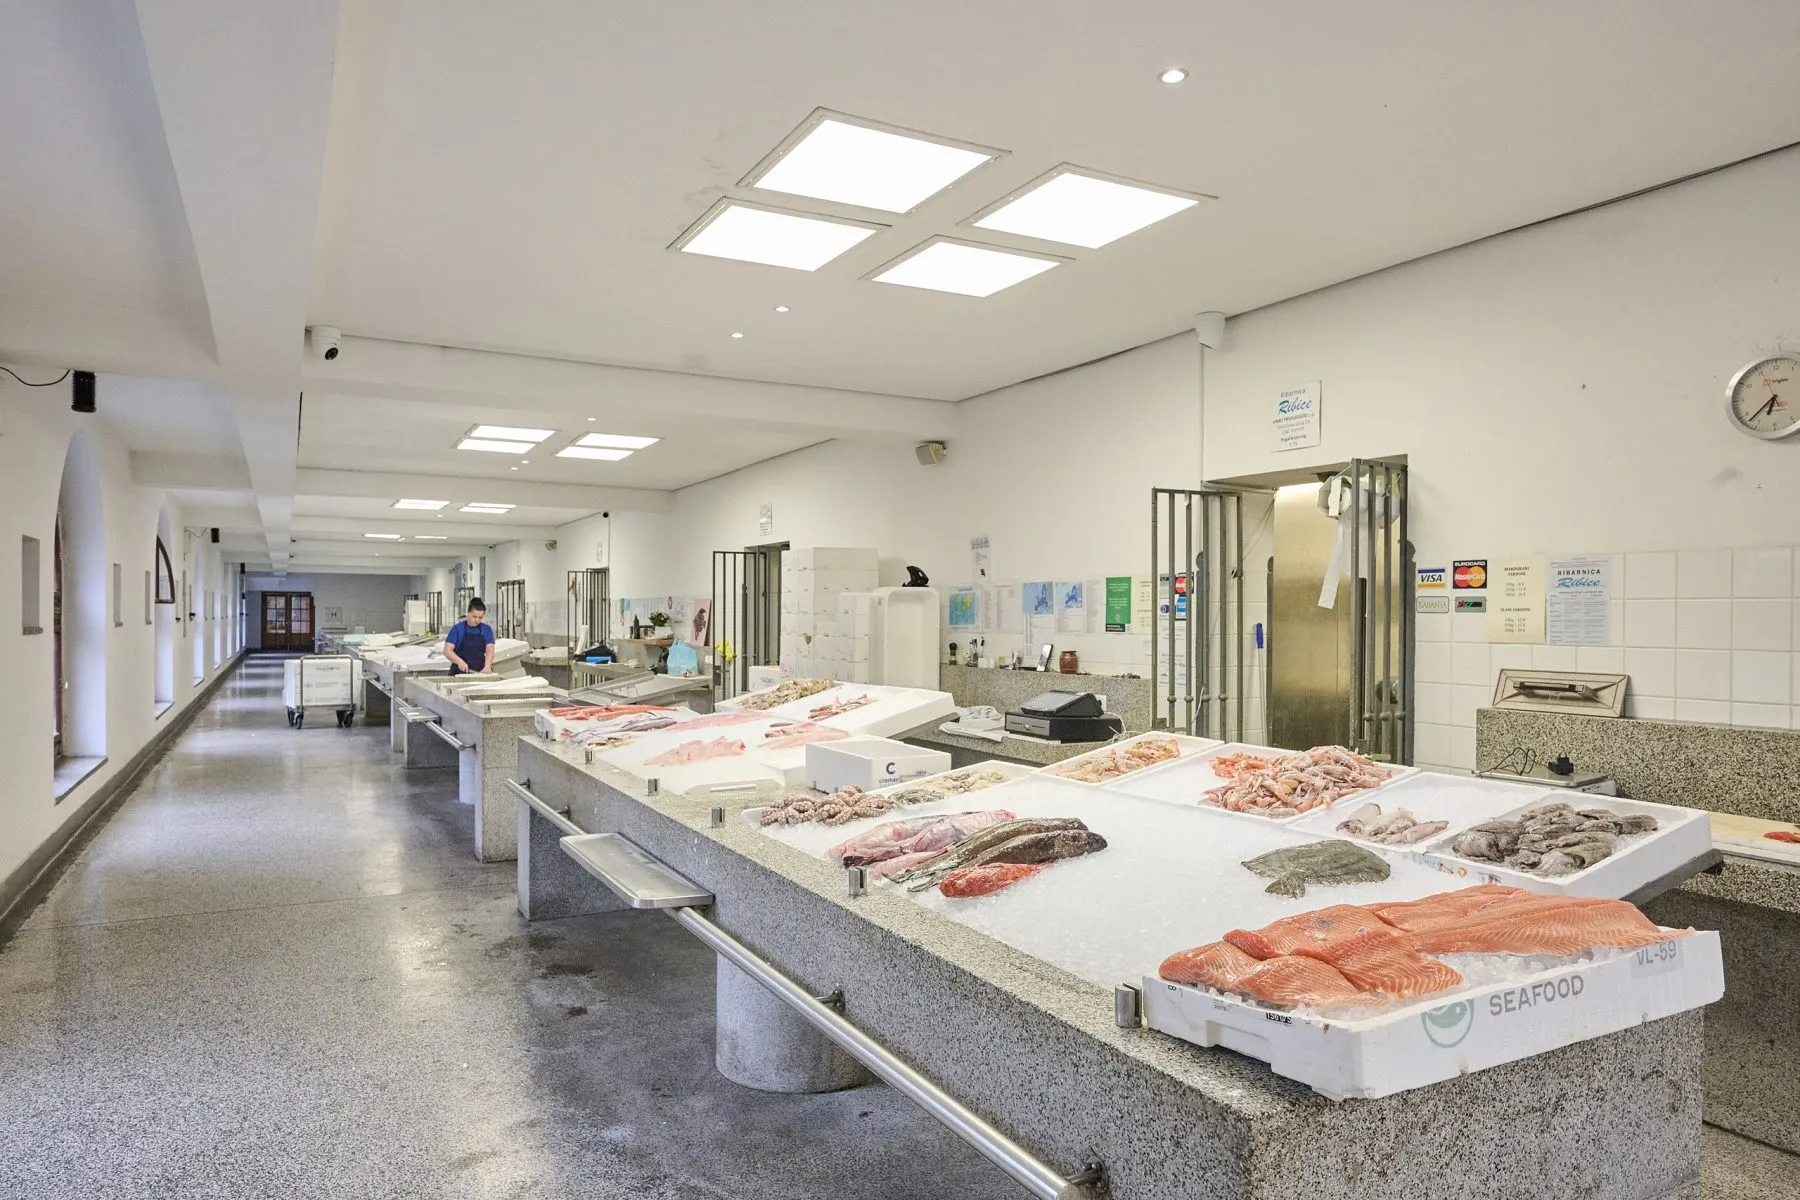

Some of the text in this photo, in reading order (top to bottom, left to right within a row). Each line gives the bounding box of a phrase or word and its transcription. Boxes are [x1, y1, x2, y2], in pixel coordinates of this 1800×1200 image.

[1278, 397, 1312, 416] Ribice
[1556, 577, 1601, 588] Ribice
[1636, 940, 1676, 966] VL-59
[1490, 975, 1584, 1016] SEAFOOD
